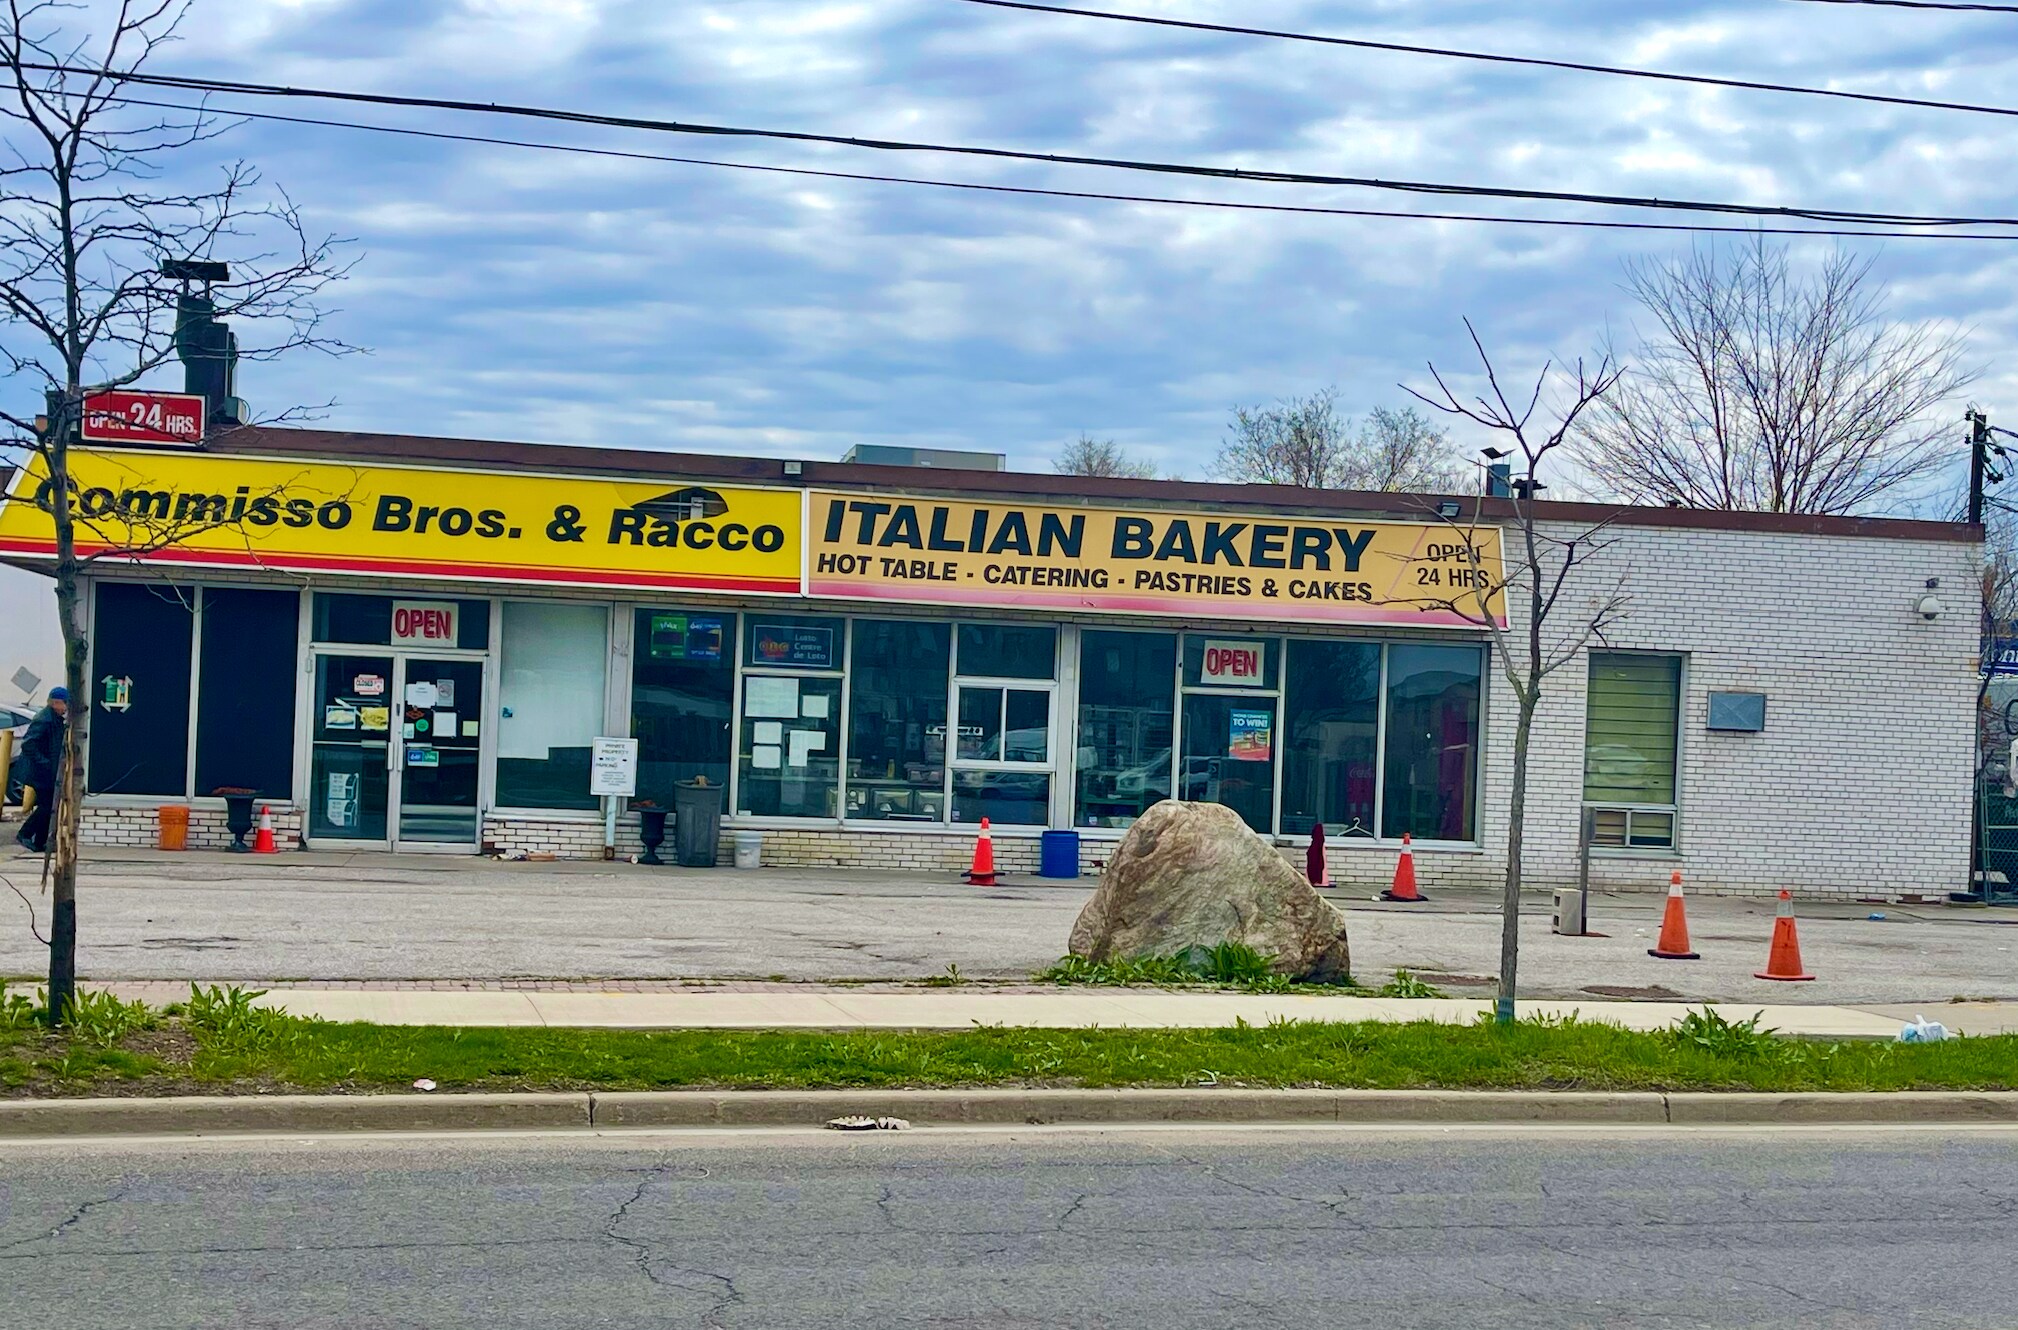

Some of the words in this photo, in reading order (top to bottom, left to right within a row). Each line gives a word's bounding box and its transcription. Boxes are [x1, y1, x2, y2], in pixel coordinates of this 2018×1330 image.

[129, 402, 162, 431] 24
[165, 415, 198, 435] HRS.
[373, 495, 522, 539] Bros.
[546, 504, 588, 543] &
[607, 508, 785, 554] Racco
[824, 499, 1087, 559] ITALIAN
[1111, 516, 1377, 573] BAKERY
[817, 553, 872, 575] HOT
[880, 558, 958, 583] TABLE
[983, 565, 1109, 589] CATERING
[1135, 570, 1252, 597] PASTRIES
[1261, 579, 1279, 598] &
[1288, 580, 1373, 602] CAKES
[1417, 567, 1440, 585] 24
[395, 608, 452, 639] OPEN
[1206, 648, 1258, 677] OPEN
[1233, 718, 1245, 727] TO
[1246, 719, 1268, 728] WIN!
